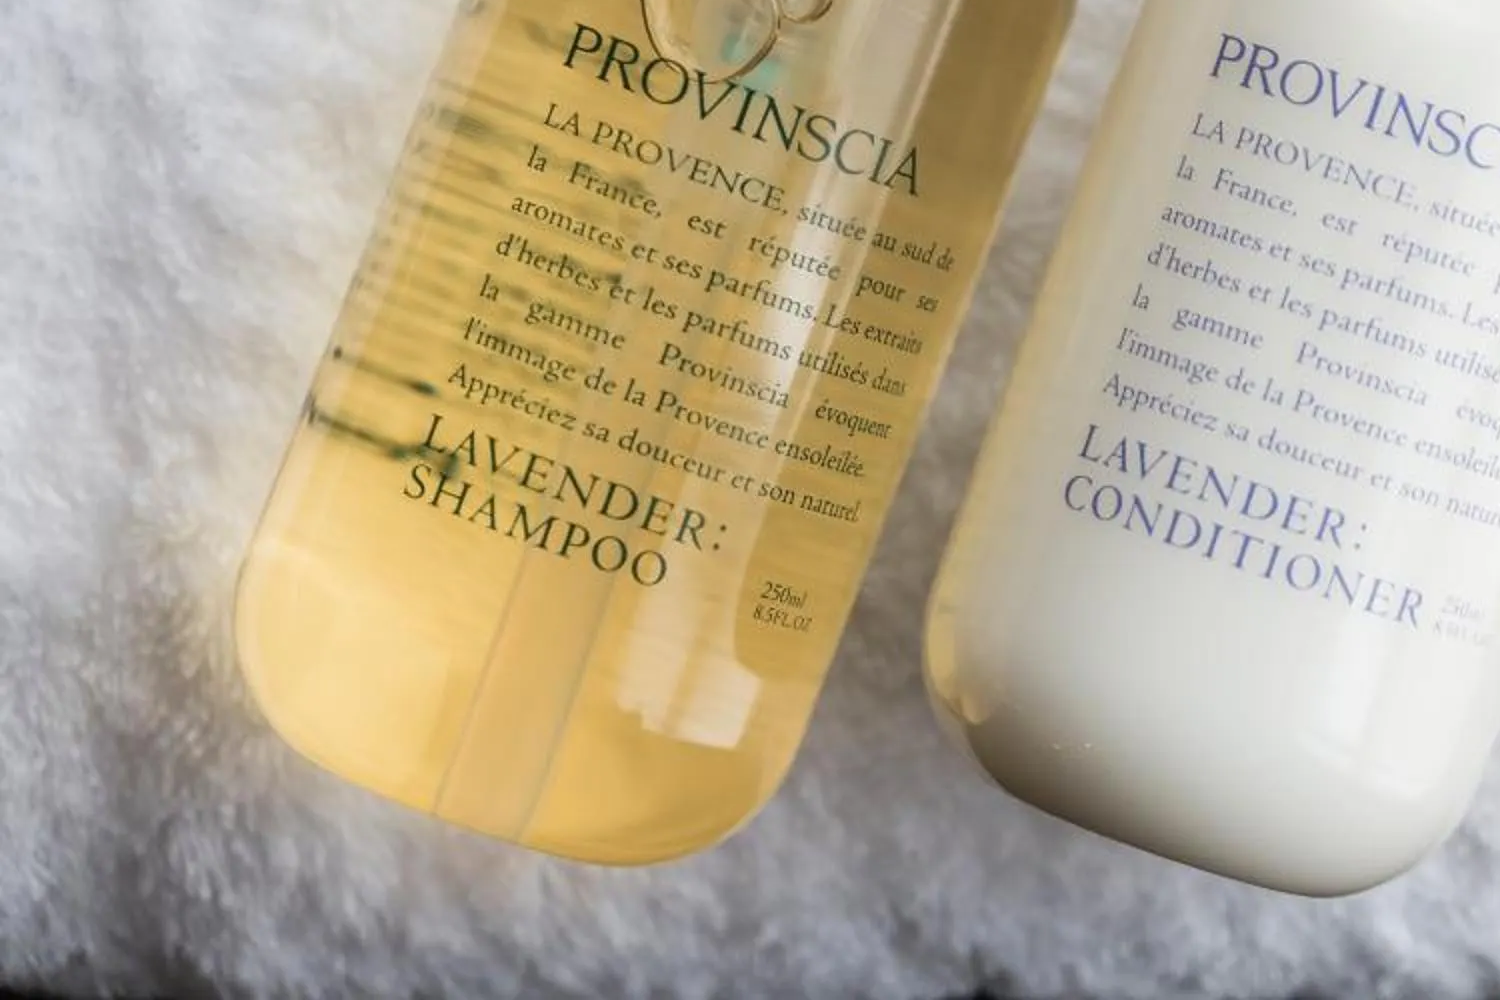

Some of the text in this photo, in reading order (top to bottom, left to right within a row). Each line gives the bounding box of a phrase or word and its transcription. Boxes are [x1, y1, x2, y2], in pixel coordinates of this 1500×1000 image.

[559, 22, 918, 196] PROVINSCIA
[1190, 112, 1224, 144] LA
[1233, 125, 1419, 215] PROVENCE,
[525, 143, 939, 313] la France, est réputée pour ses
[541, 102, 955, 271] LA PROVENCE, située au sud de
[1175, 153, 1195, 181] la
[1211, 166, 1297, 220] France,
[1321, 211, 1360, 236] est
[510, 196, 922, 355] aromates et ses parfums. Les extraits
[1160, 206, 1264, 252] aromates
[1268, 241, 1295, 263] et
[1298, 252, 1336, 277] ses
[1338, 266, 1454, 319] parfums.
[1460, 300, 1497, 333] Les
[1248, 283, 1273, 303] et
[1278, 284, 1313, 317] les
[1316, 307, 1427, 357] parfums
[478, 273, 894, 440] la gamme Provinscia évoquent
[608, 283, 639, 305] et
[640, 285, 679, 319] les
[679, 309, 793, 359] parfums
[796, 347, 869, 384] utilisés
[871, 366, 907, 397] dans
[1131, 283, 1150, 310] la
[1172, 307, 1264, 348] gamme
[1294, 340, 1428, 406] Provinscia
[446, 362, 578, 431] Appréciez
[582, 421, 611, 443] sa
[617, 427, 728, 481] douceur
[730, 471, 756, 491] et
[758, 480, 798, 505] son
[583, 365, 617, 395] de
[622, 377, 646, 406] la
[653, 389, 769, 448] Provence
[1101, 372, 1219, 433] Appréciez
[1224, 422, 1250, 443] sa
[1257, 427, 1366, 480] douceur
[1370, 470, 1394, 491] et
[1397, 480, 1442, 508] son
[1224, 366, 1255, 395] de
[1260, 376, 1285, 405] la
[1291, 388, 1408, 447] Provence
[402, 463, 669, 588] SHAMPOO
[420, 414, 728, 555] LAVENDER:
[1076, 423, 1368, 554] LAVENDER:
[1062, 473, 1422, 628] CONDITIONER
